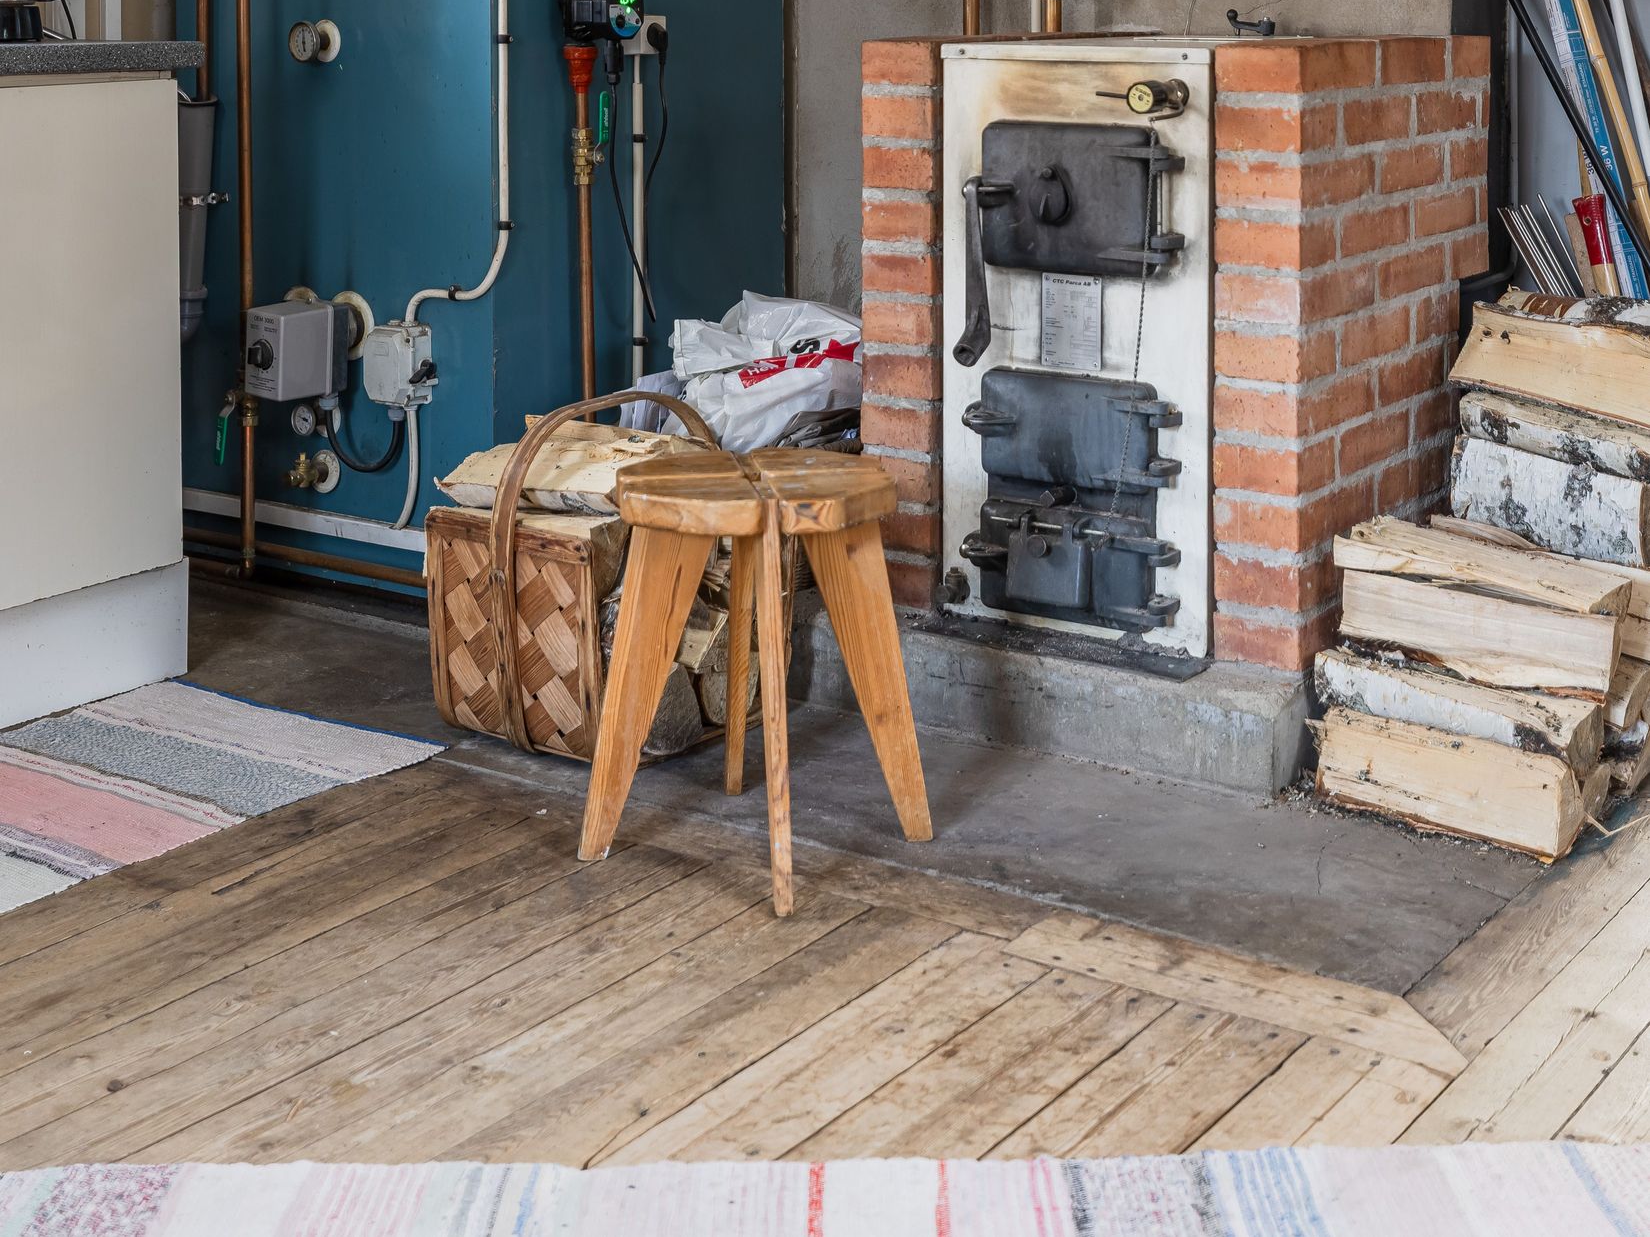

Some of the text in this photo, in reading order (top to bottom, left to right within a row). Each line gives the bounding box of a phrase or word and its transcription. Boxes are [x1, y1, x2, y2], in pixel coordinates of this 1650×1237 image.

[1578, 62, 1588, 88] STANDARD
[1599, 145, 1613, 171] 36 W
